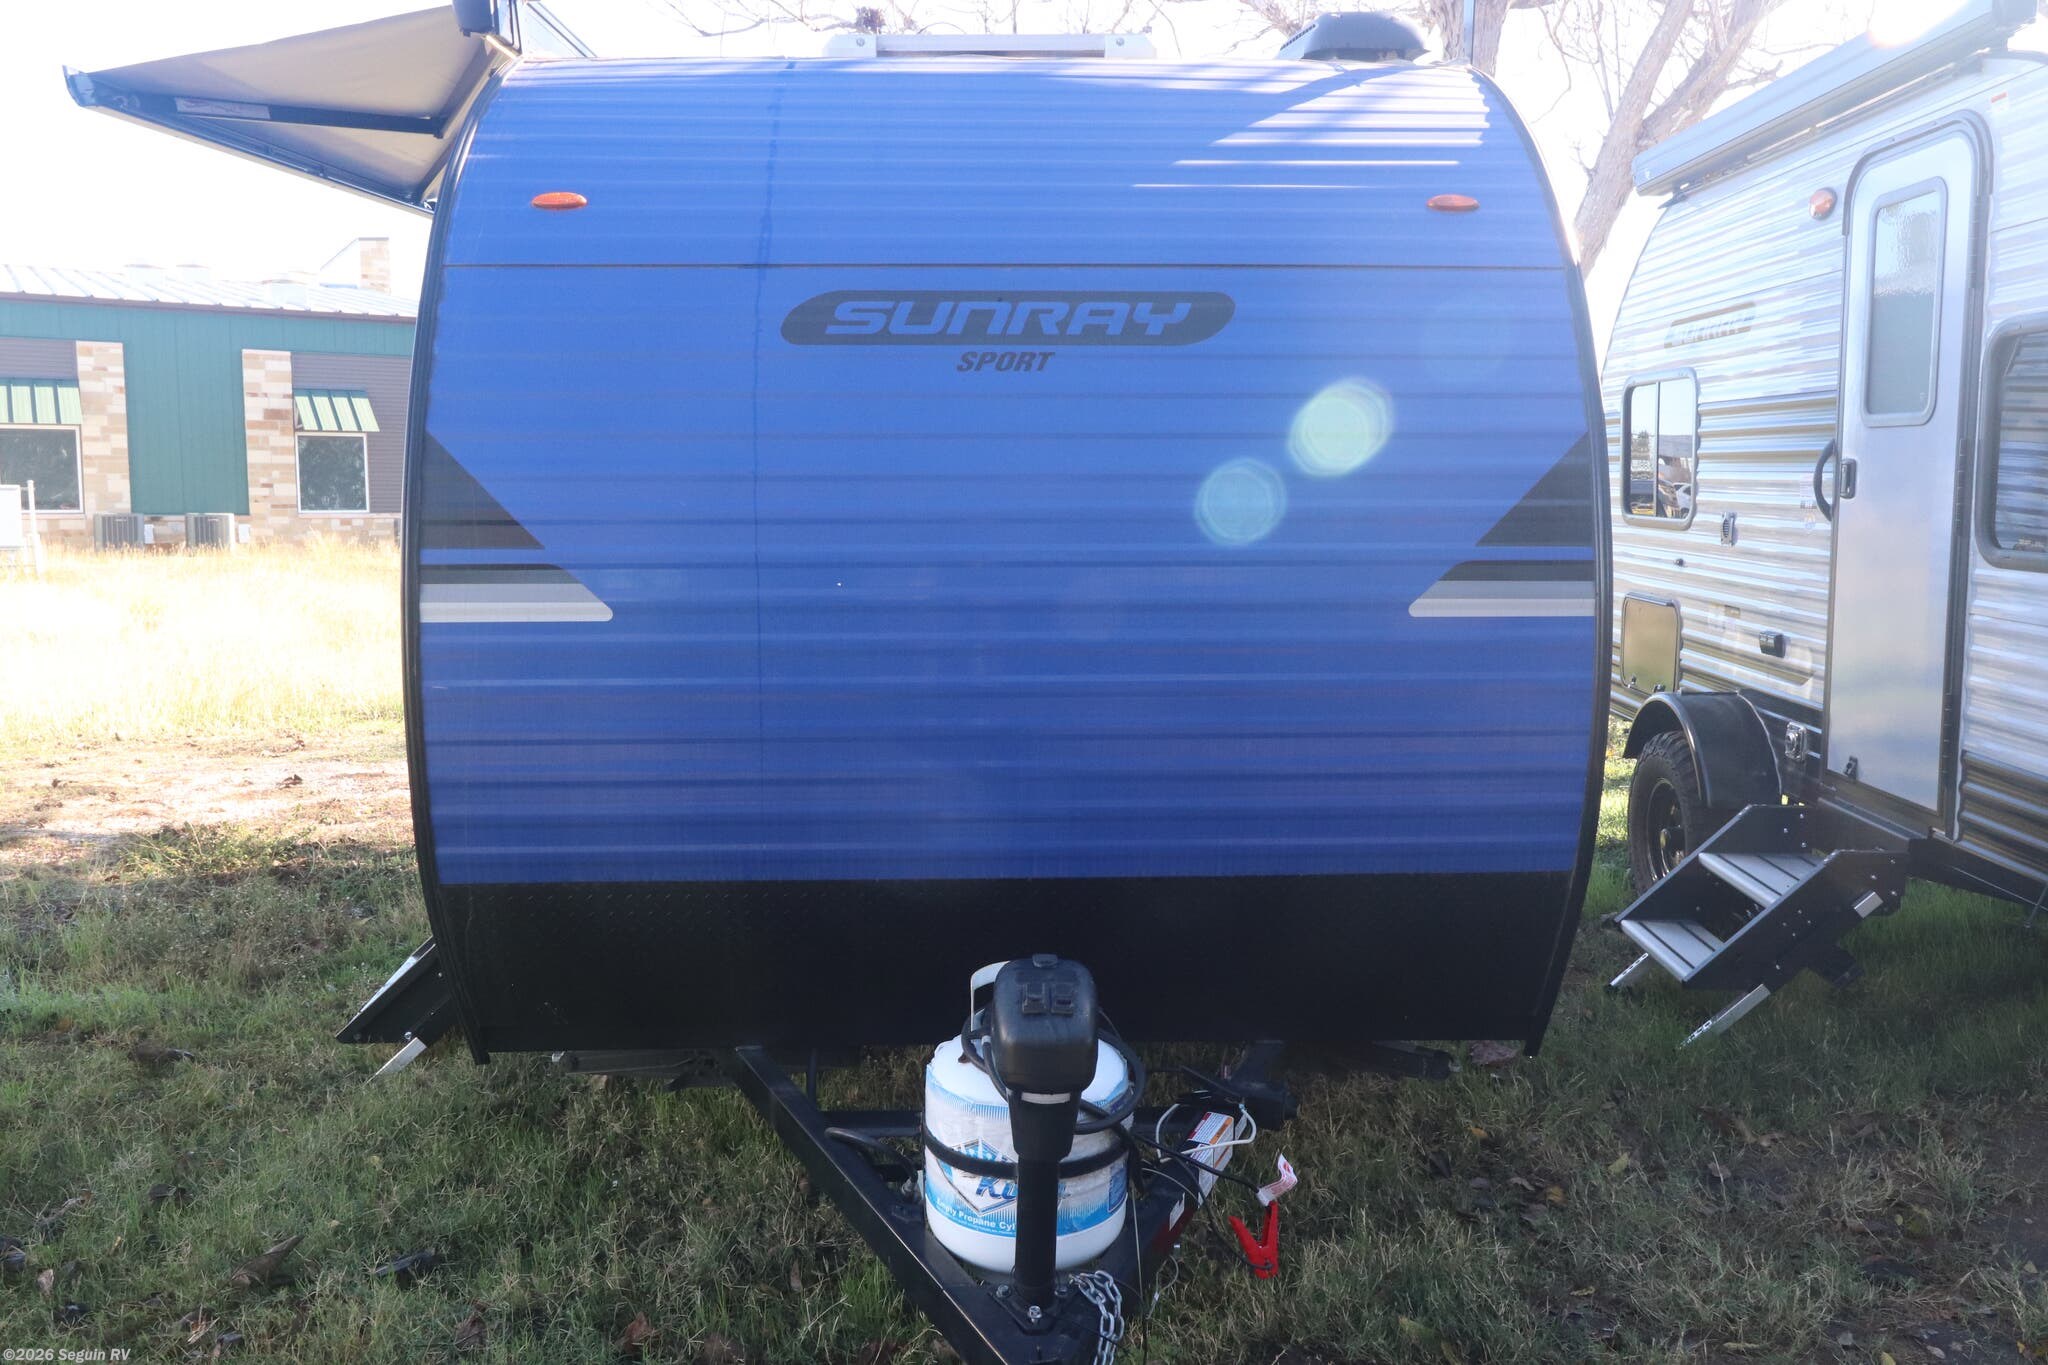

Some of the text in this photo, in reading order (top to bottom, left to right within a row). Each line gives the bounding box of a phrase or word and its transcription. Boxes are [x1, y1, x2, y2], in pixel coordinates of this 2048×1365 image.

[824, 300, 1192, 336] SUNRAY
[955, 350, 1055, 373] SPORT
[959, 1211, 995, 1227] Propane
